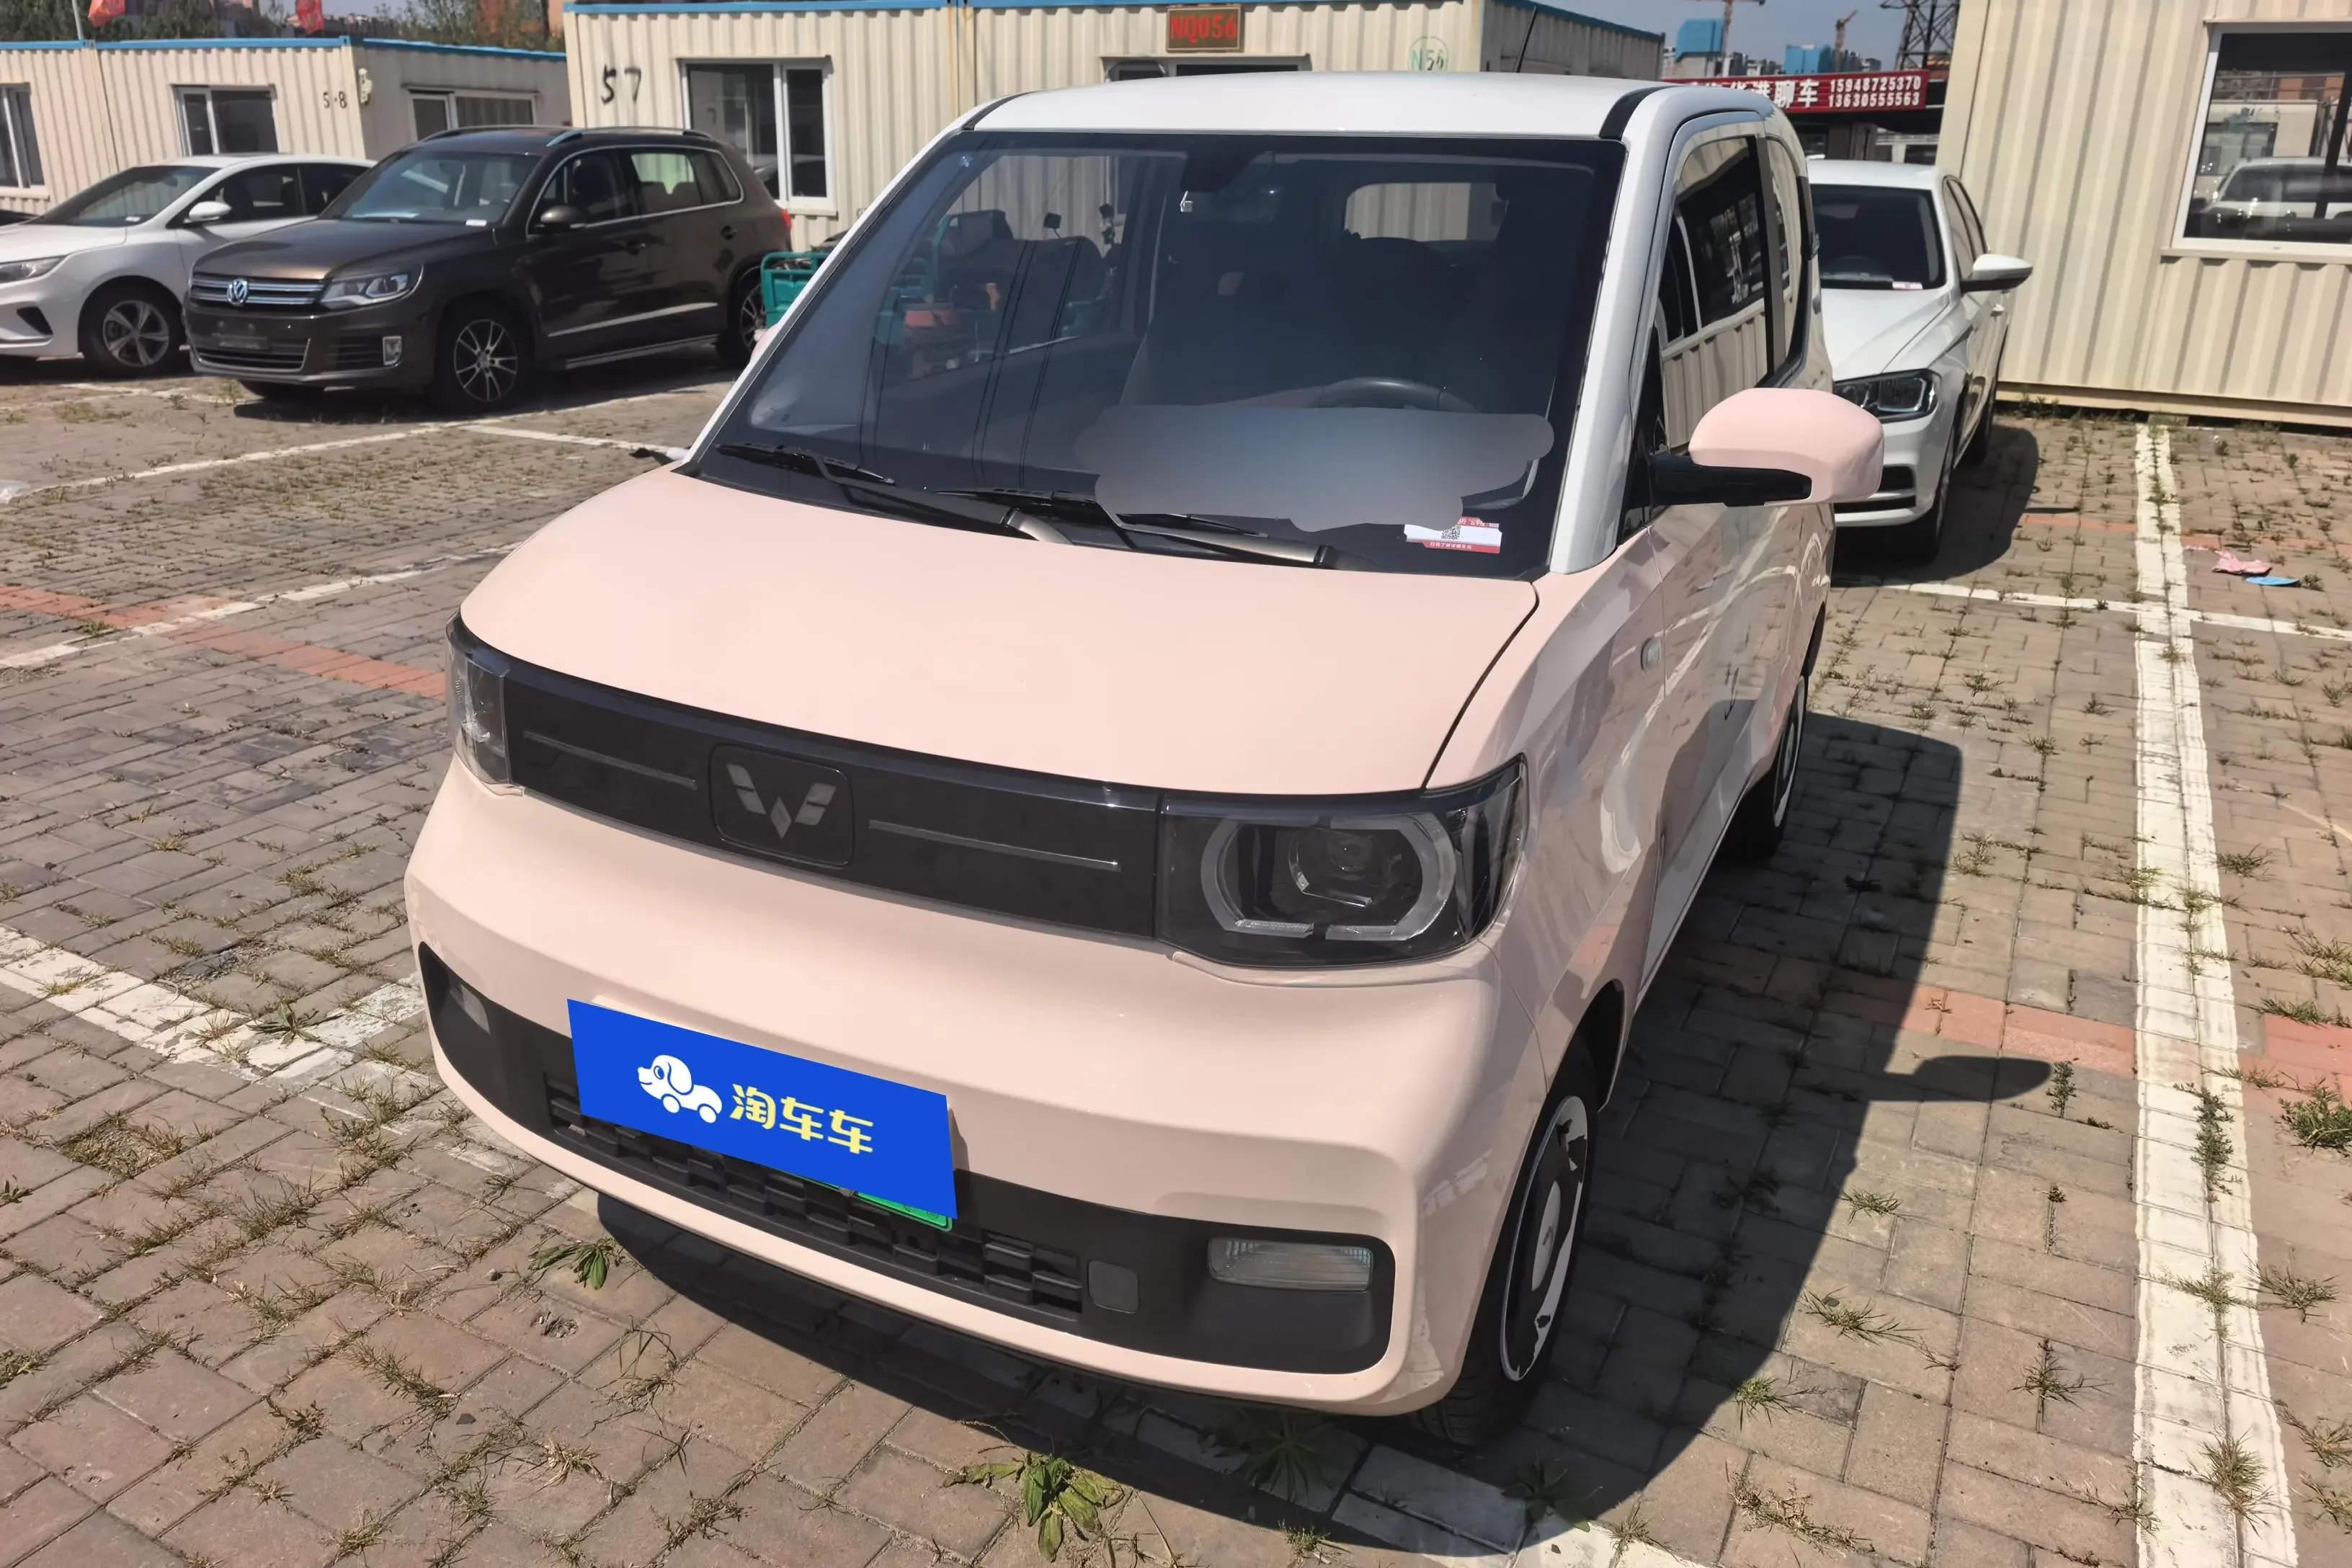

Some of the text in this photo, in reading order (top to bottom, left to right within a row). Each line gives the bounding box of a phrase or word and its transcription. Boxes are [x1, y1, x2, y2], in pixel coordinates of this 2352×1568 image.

[1170, 14, 1237, 43] NQ056
[1830, 76, 1921, 93] 15948725370
[1829, 92, 1920, 107] 13630555563
